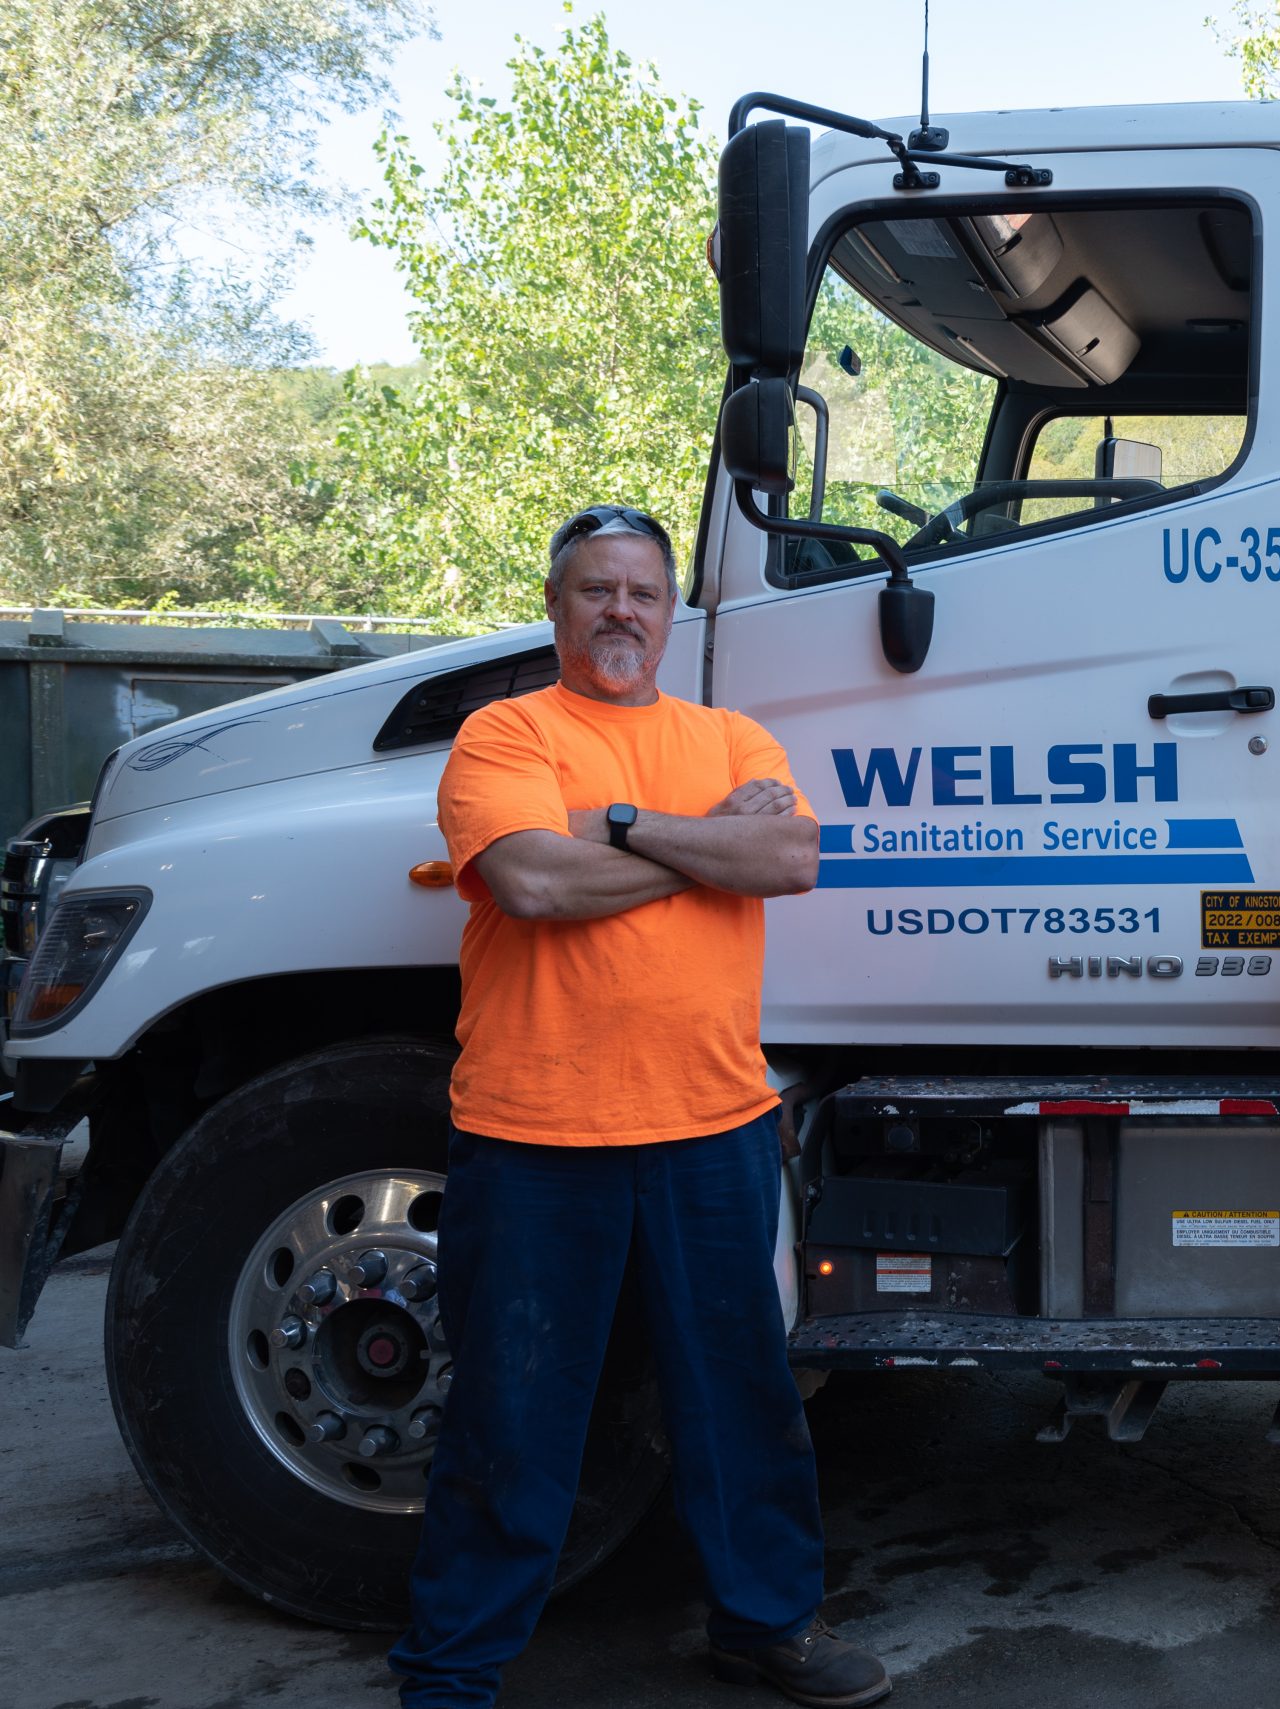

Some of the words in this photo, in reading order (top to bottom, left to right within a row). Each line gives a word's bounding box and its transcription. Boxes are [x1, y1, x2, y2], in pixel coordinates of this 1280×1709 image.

[831, 742, 1179, 808] WELSH
[863, 820, 1025, 853] Sanitation
[1042, 819, 1158, 850] Service
[1206, 895, 1224, 908] CITY
[1229, 895, 1240, 908] OF
[866, 907, 1162, 936] USDOT783531
[1207, 932, 1230, 945] TAX
[1048, 955, 1184, 979] HINO
[1194, 955, 1273, 977] 338
